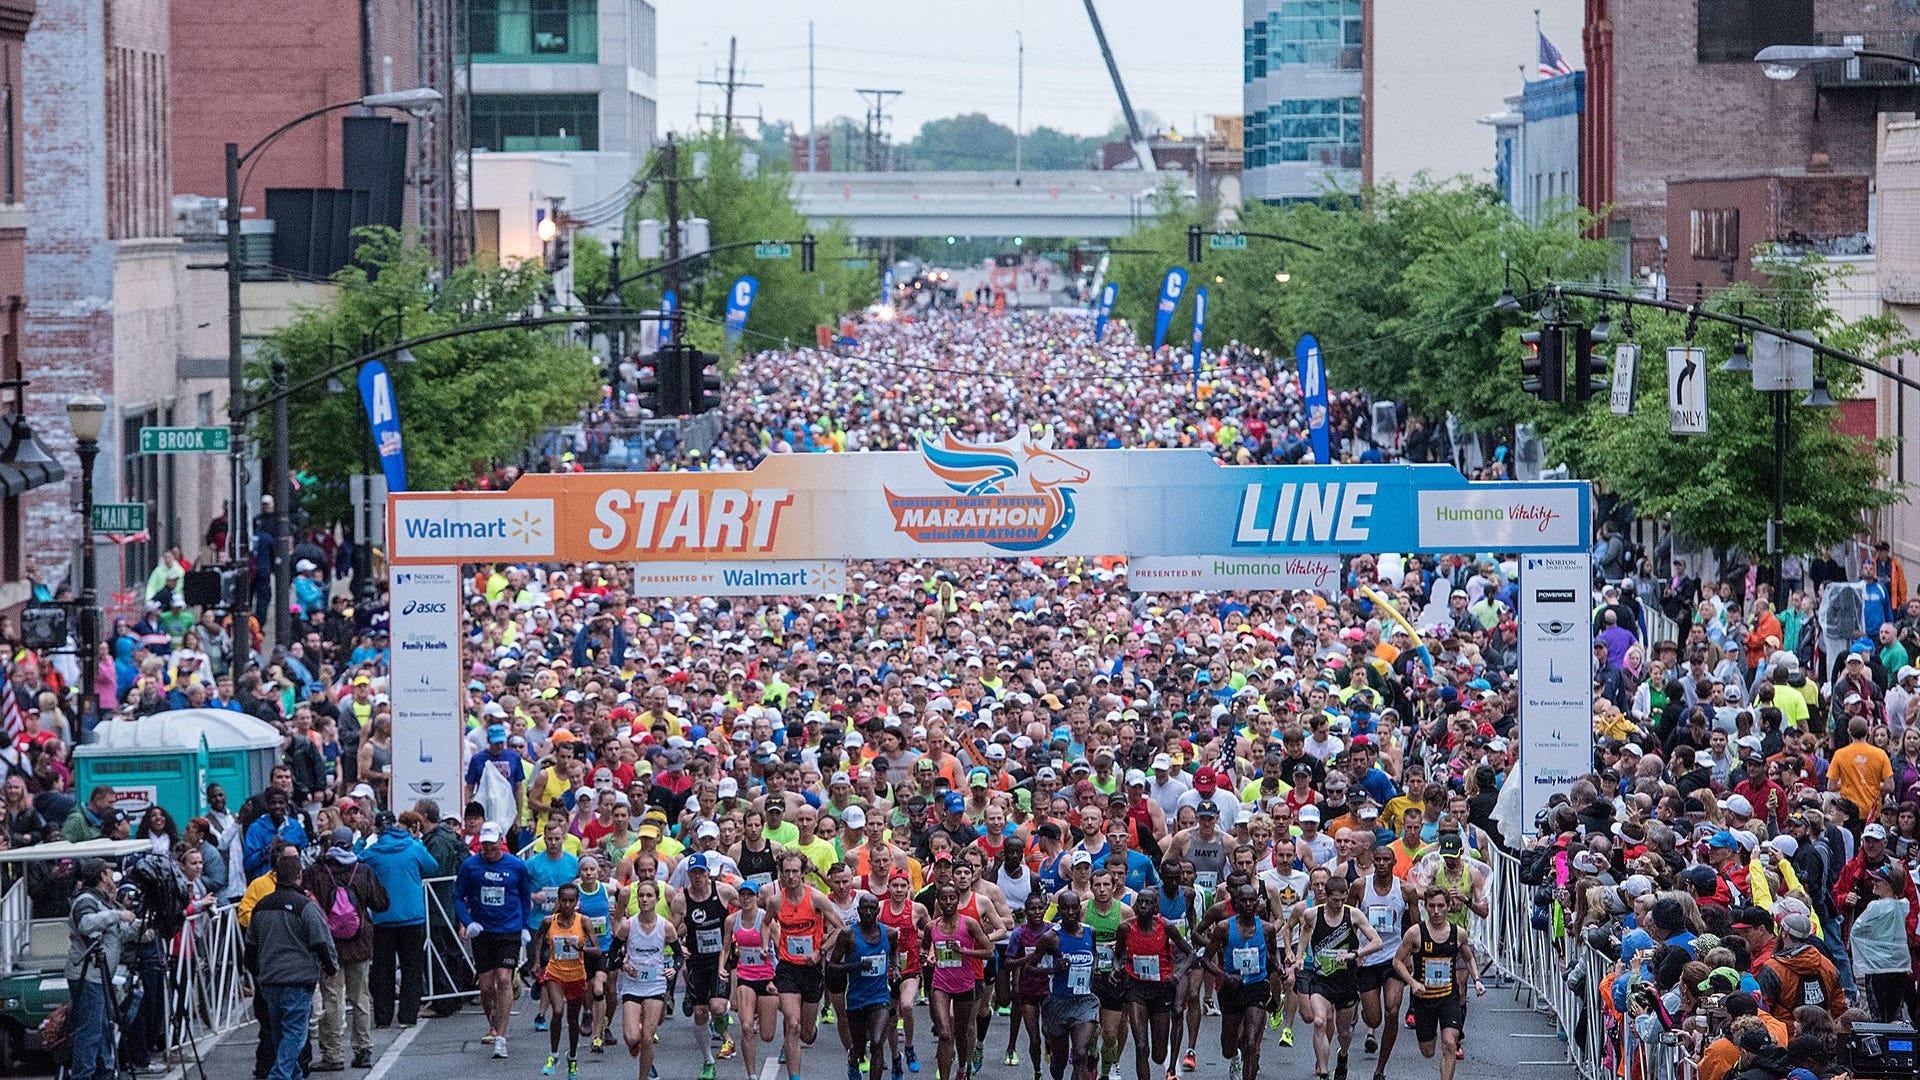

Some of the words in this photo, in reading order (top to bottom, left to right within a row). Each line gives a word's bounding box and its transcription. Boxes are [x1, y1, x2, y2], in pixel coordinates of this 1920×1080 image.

[735, 281, 750, 306] C
[1166, 272, 1182, 298] C
[1620, 353, 1629, 368] DO
[1305, 347, 1319, 398] A
[373, 372, 392, 425] A
[1612, 391, 1629, 407] ENTER
[1673, 411, 1702, 426] ONLY
[158, 431, 205, 449] BROOK
[892, 499, 950, 507] KENTUCKY
[997, 498, 1046, 506] FESTIVAL
[101, 507, 129, 529] MAIN
[588, 487, 793, 552] START
[900, 507, 1047, 527] MARATHON
[1233, 481, 1378, 546] LINE
[1436, 506, 1504, 521] Humana
[1508, 503, 1560, 532] Vitality
[405, 517, 506, 539] Walmart
[918, 527, 1039, 540] miniMARATHON
[640, 575, 698, 583] PRESENTED
[701, 575, 714, 583] BY
[722, 568, 807, 587] Walmart
[1135, 569, 1188, 578] PRESENTED
[1191, 569, 1203, 577] BY
[1213, 560, 1281, 575] Humana
[1285, 557, 1336, 588] Vitality
[402, 641, 424, 652] Family
[425, 641, 448, 650] Health
[1534, 775, 1556, 786] Family
[1194, 849, 1218, 858] NAVY
